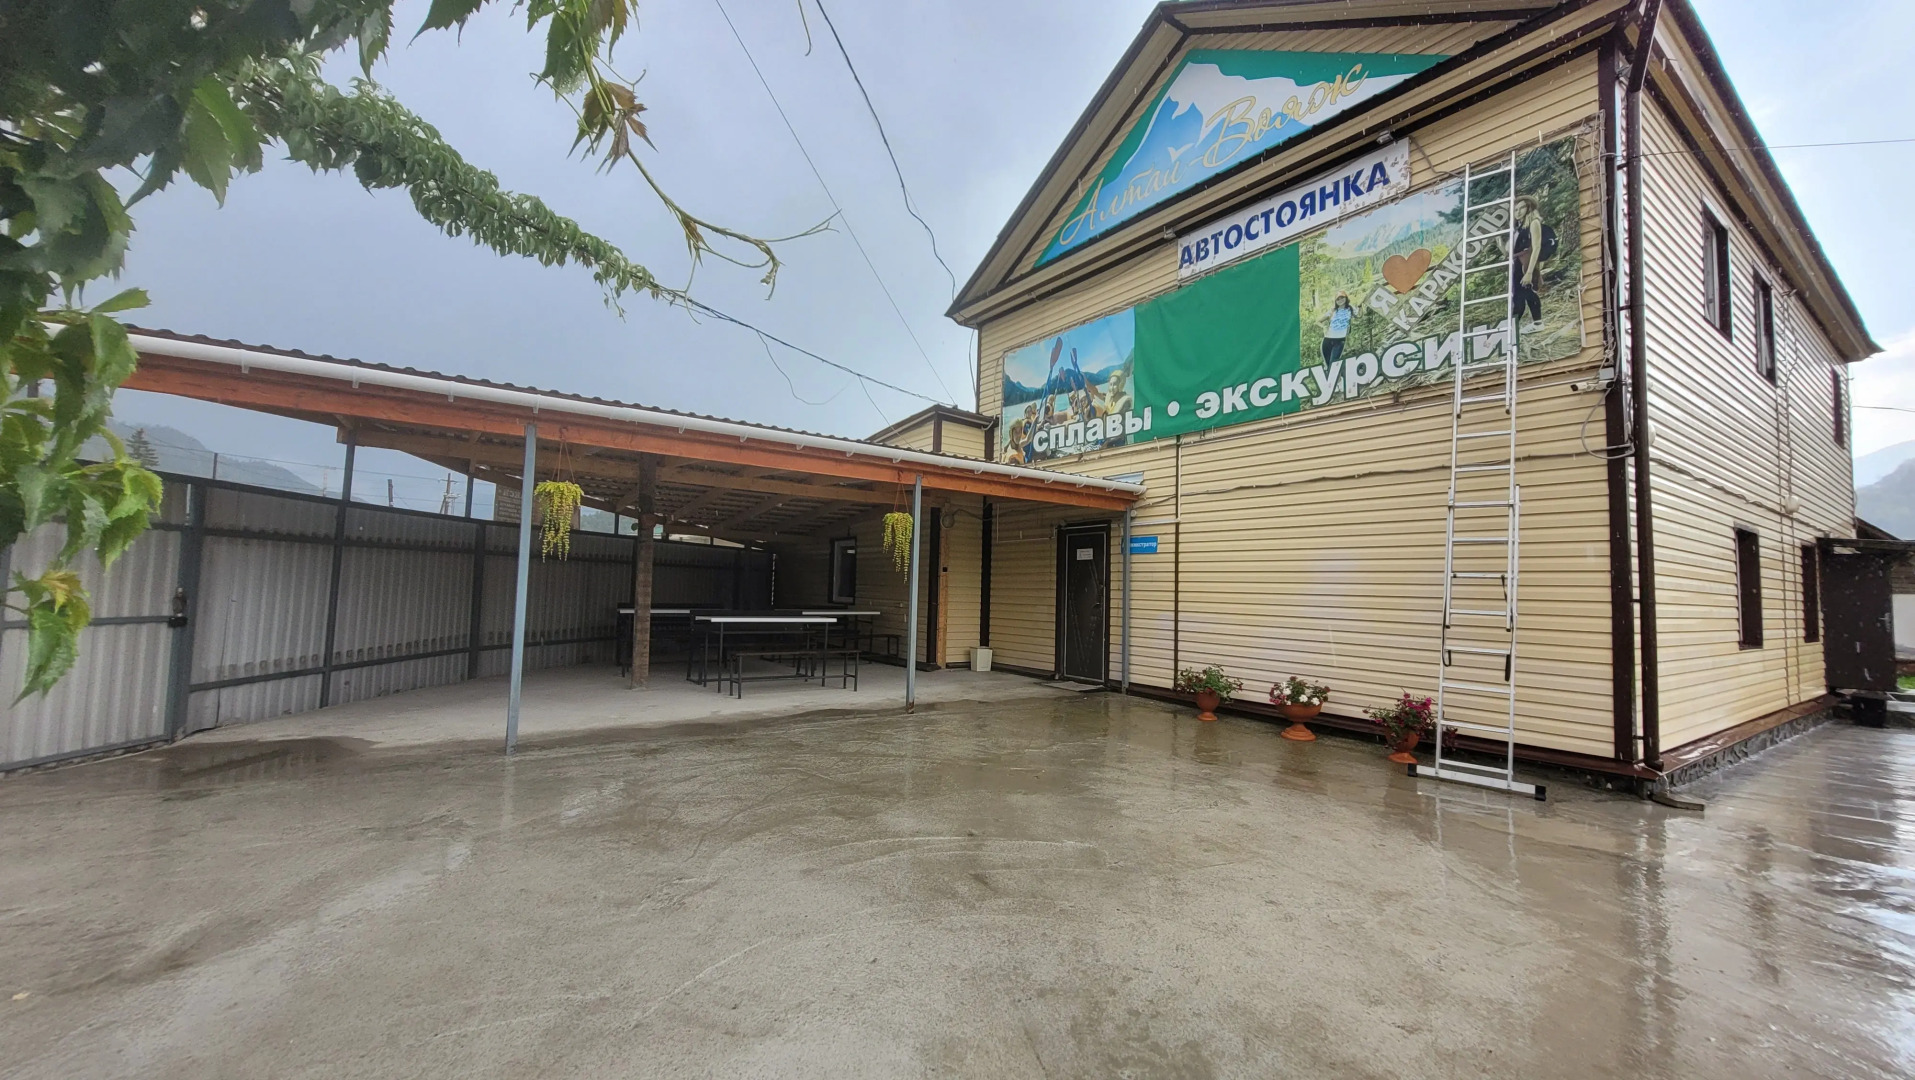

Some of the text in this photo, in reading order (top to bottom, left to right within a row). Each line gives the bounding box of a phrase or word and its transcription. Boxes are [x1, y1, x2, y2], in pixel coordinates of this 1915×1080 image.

[1178, 160, 1391, 270] АВТОСТОЯНКА
[1391, 201, 1509, 332] КАРАКОЛЫ
[1369, 286, 1399, 316] Я
[1033, 317, 1517, 453] сплавы экскурсии
